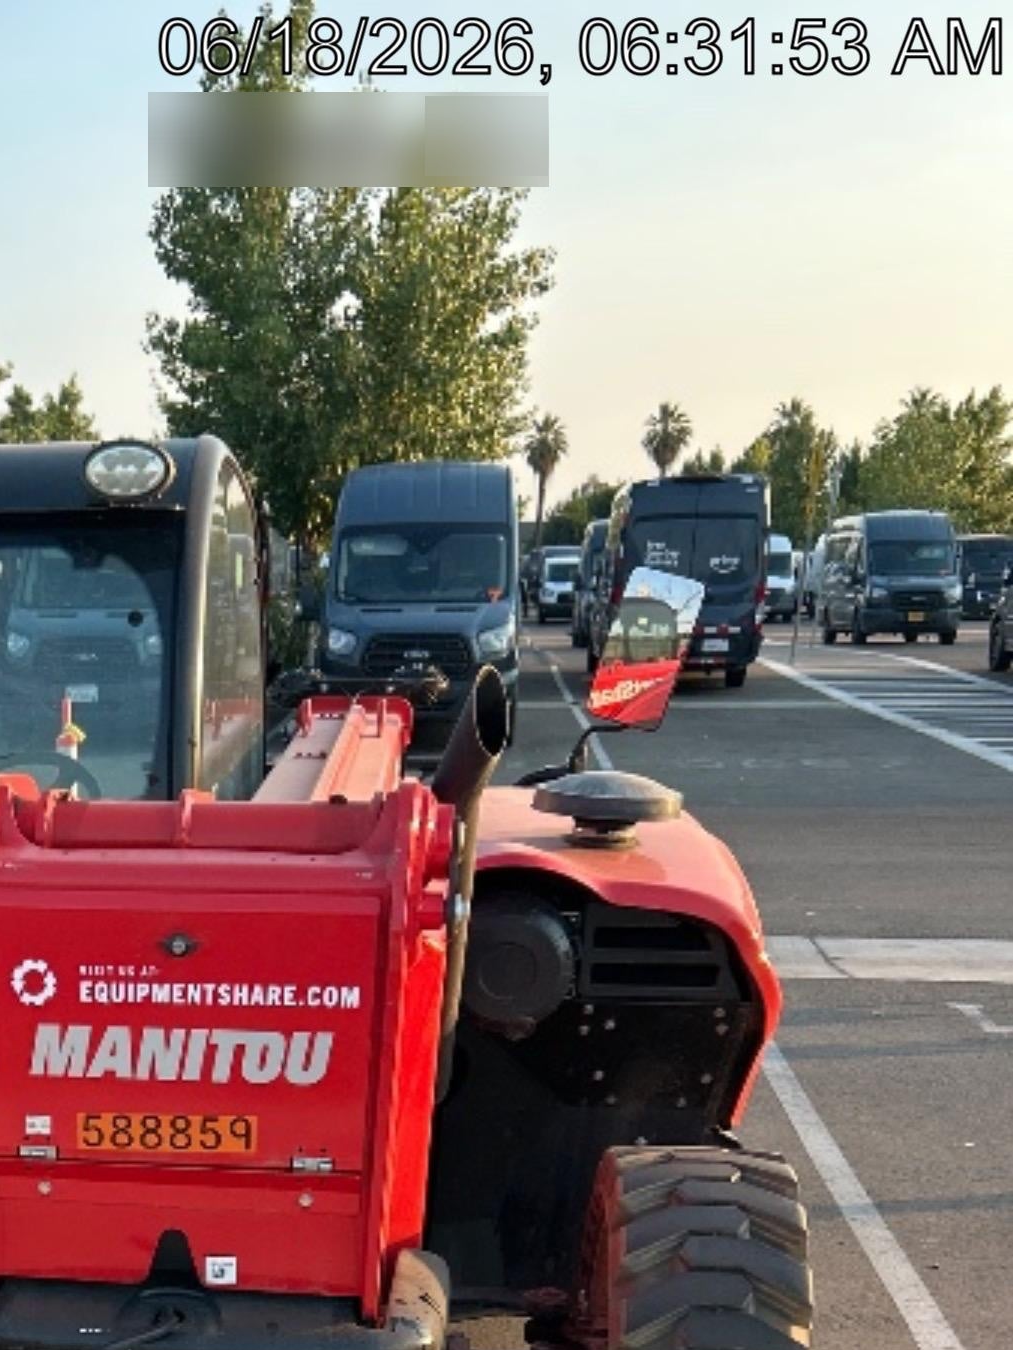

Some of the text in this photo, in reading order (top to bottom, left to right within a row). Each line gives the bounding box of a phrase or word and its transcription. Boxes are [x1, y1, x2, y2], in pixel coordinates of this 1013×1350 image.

[79, 980, 361, 1010] EQUIPMENTSHARE.COM
[29, 1023, 334, 1085] MANITOU
[82, 1114, 252, 1150] 588859
